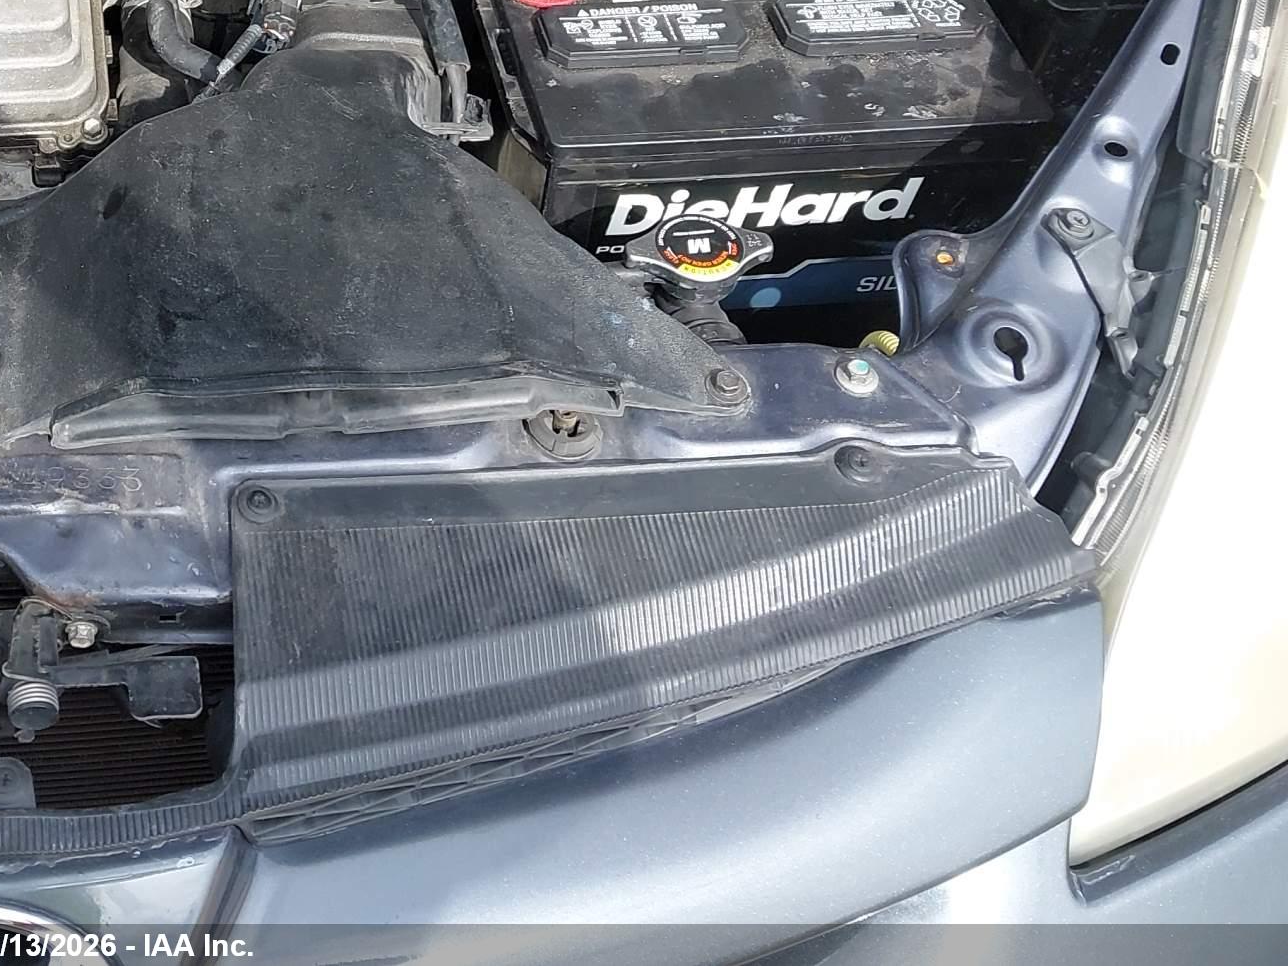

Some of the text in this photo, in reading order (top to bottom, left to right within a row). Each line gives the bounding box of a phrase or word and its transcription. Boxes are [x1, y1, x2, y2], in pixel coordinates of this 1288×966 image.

[589, 6, 640, 17] DANGER
[653, 3, 698, 13] POISON
[605, 177, 925, 236] DieHard
[596, 245, 625, 255] PO
[856, 275, 897, 292] SIL
